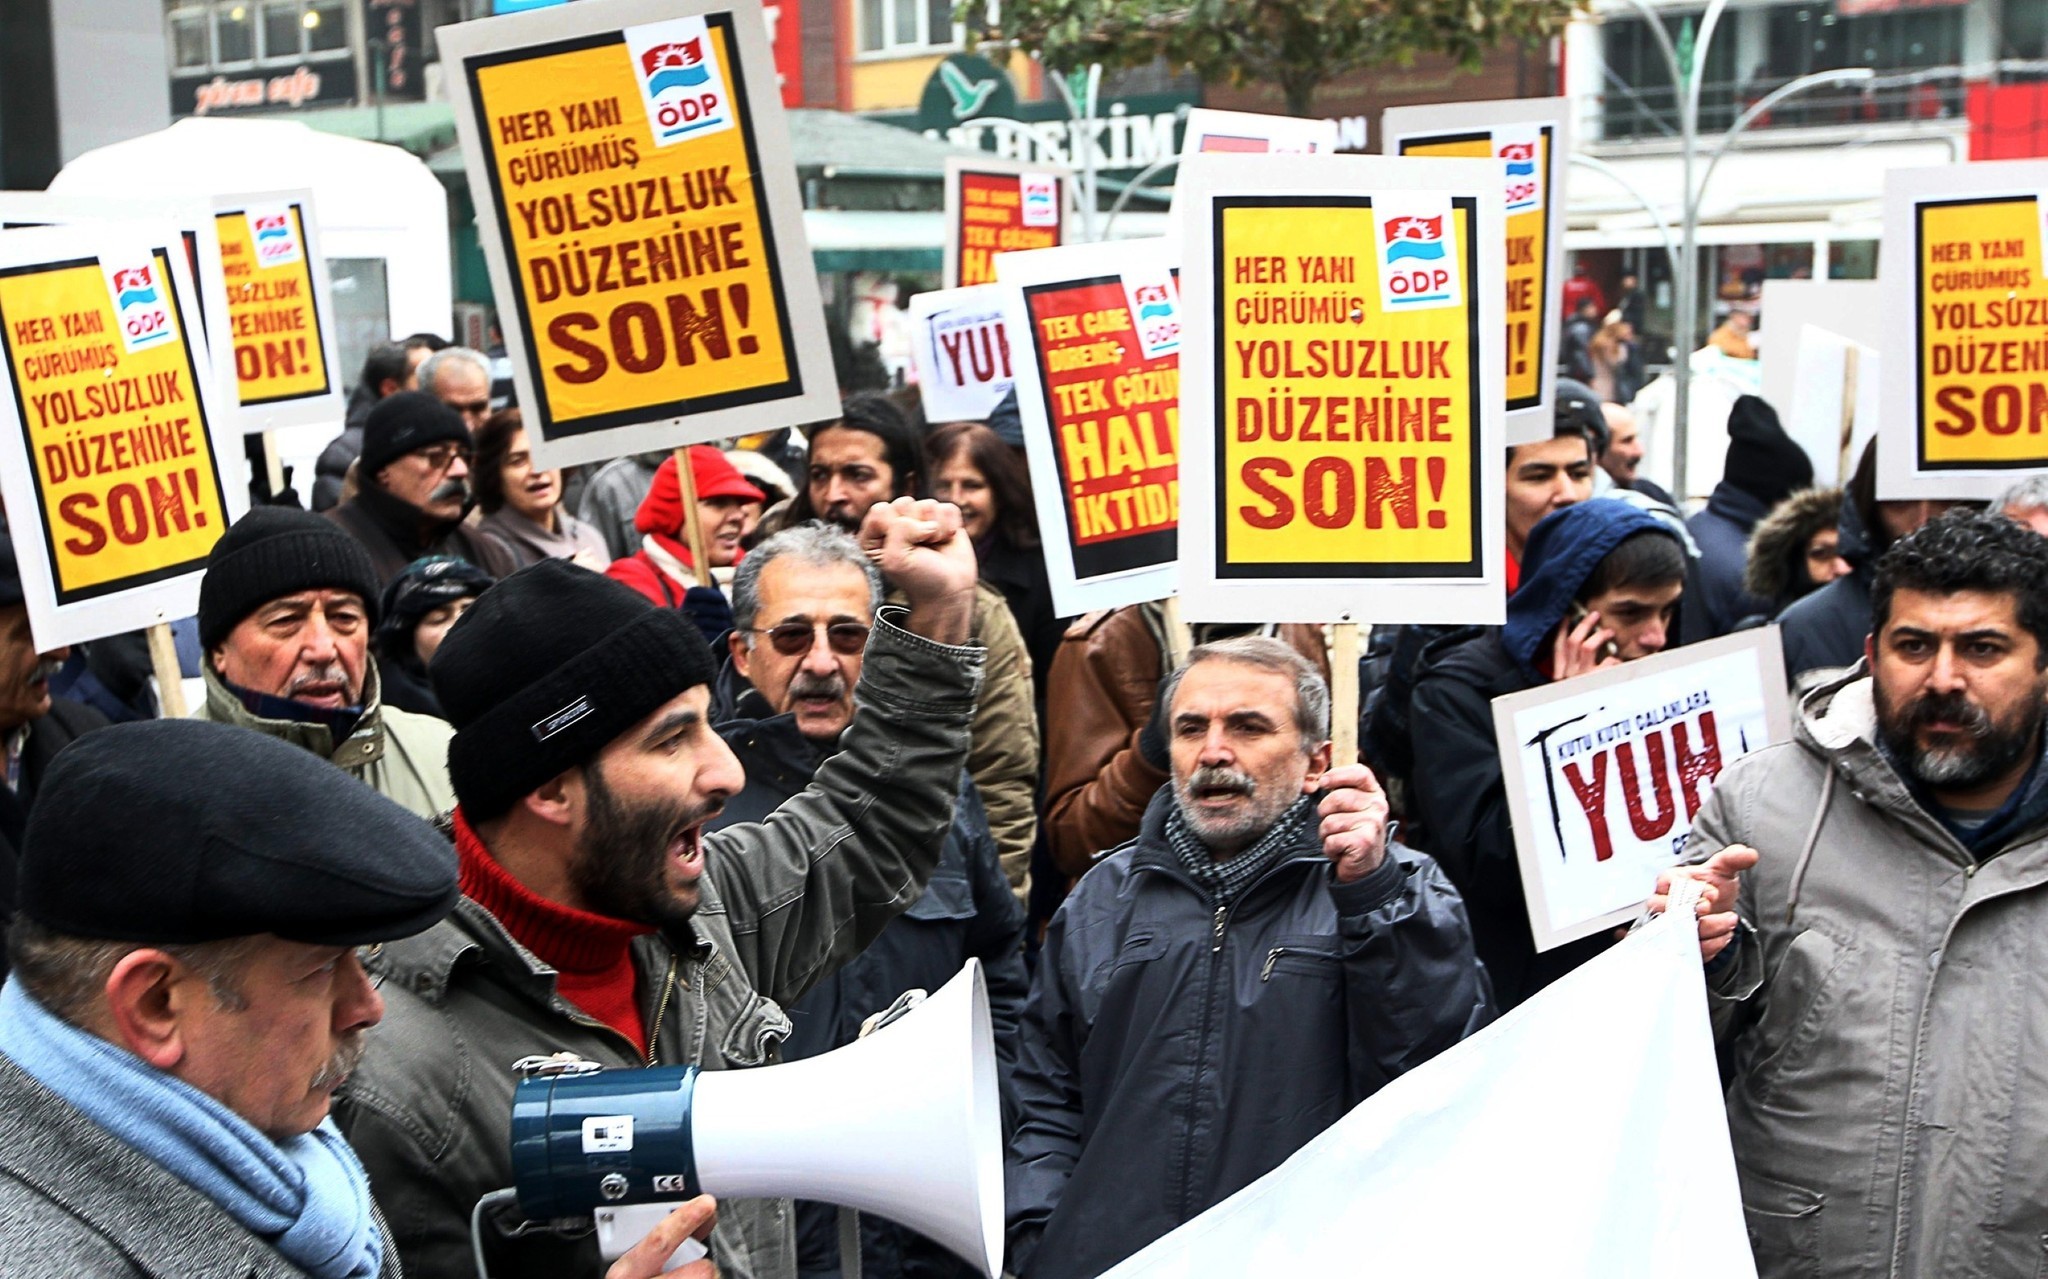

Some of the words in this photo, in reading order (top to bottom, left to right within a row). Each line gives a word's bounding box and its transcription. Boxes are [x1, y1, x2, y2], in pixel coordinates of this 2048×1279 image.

[499, 110, 555, 145] HER
[560, 97, 622, 133] YANI
[657, 93, 718, 127] ÖDP
[508, 133, 640, 189] ÇÜRÜMÜŞ
[516, 165, 738, 239] YOLSUZLUK
[529, 221, 750, 303] DÜZENİNE
[1235, 256, 1287, 283] HER
[1297, 256, 1355, 283] YANI
[1931, 242, 1971, 263] HER
[1980, 239, 2024, 260] YANI
[1389, 270, 1449, 295] ÖDP
[14, 316, 57, 346] HER
[60, 309, 104, 338] YANI
[127, 311, 166, 337] ÖDP
[1040, 314, 1082, 342] TEK
[1235, 291, 1366, 327] ÇÜRÜMÜŞ
[547, 283, 760, 384] SON!
[24, 339, 119, 382] ÇÜRÜMÜŞ
[235, 337, 310, 381] ON!
[1235, 340, 1451, 379] YOLSUZLUK
[32, 370, 184, 428] YOLSUZLUK
[1053, 379, 1111, 416] TEK
[1237, 386, 1452, 442] DÜZENİNE
[43, 415, 196, 484] DÜZENİNE
[59, 468, 207, 556] SON!
[1239, 456, 1447, 529] SON!
[1558, 734, 1592, 760] KUTU
[1596, 719, 1630, 745] KUTU
[1562, 710, 1723, 862] YUH
